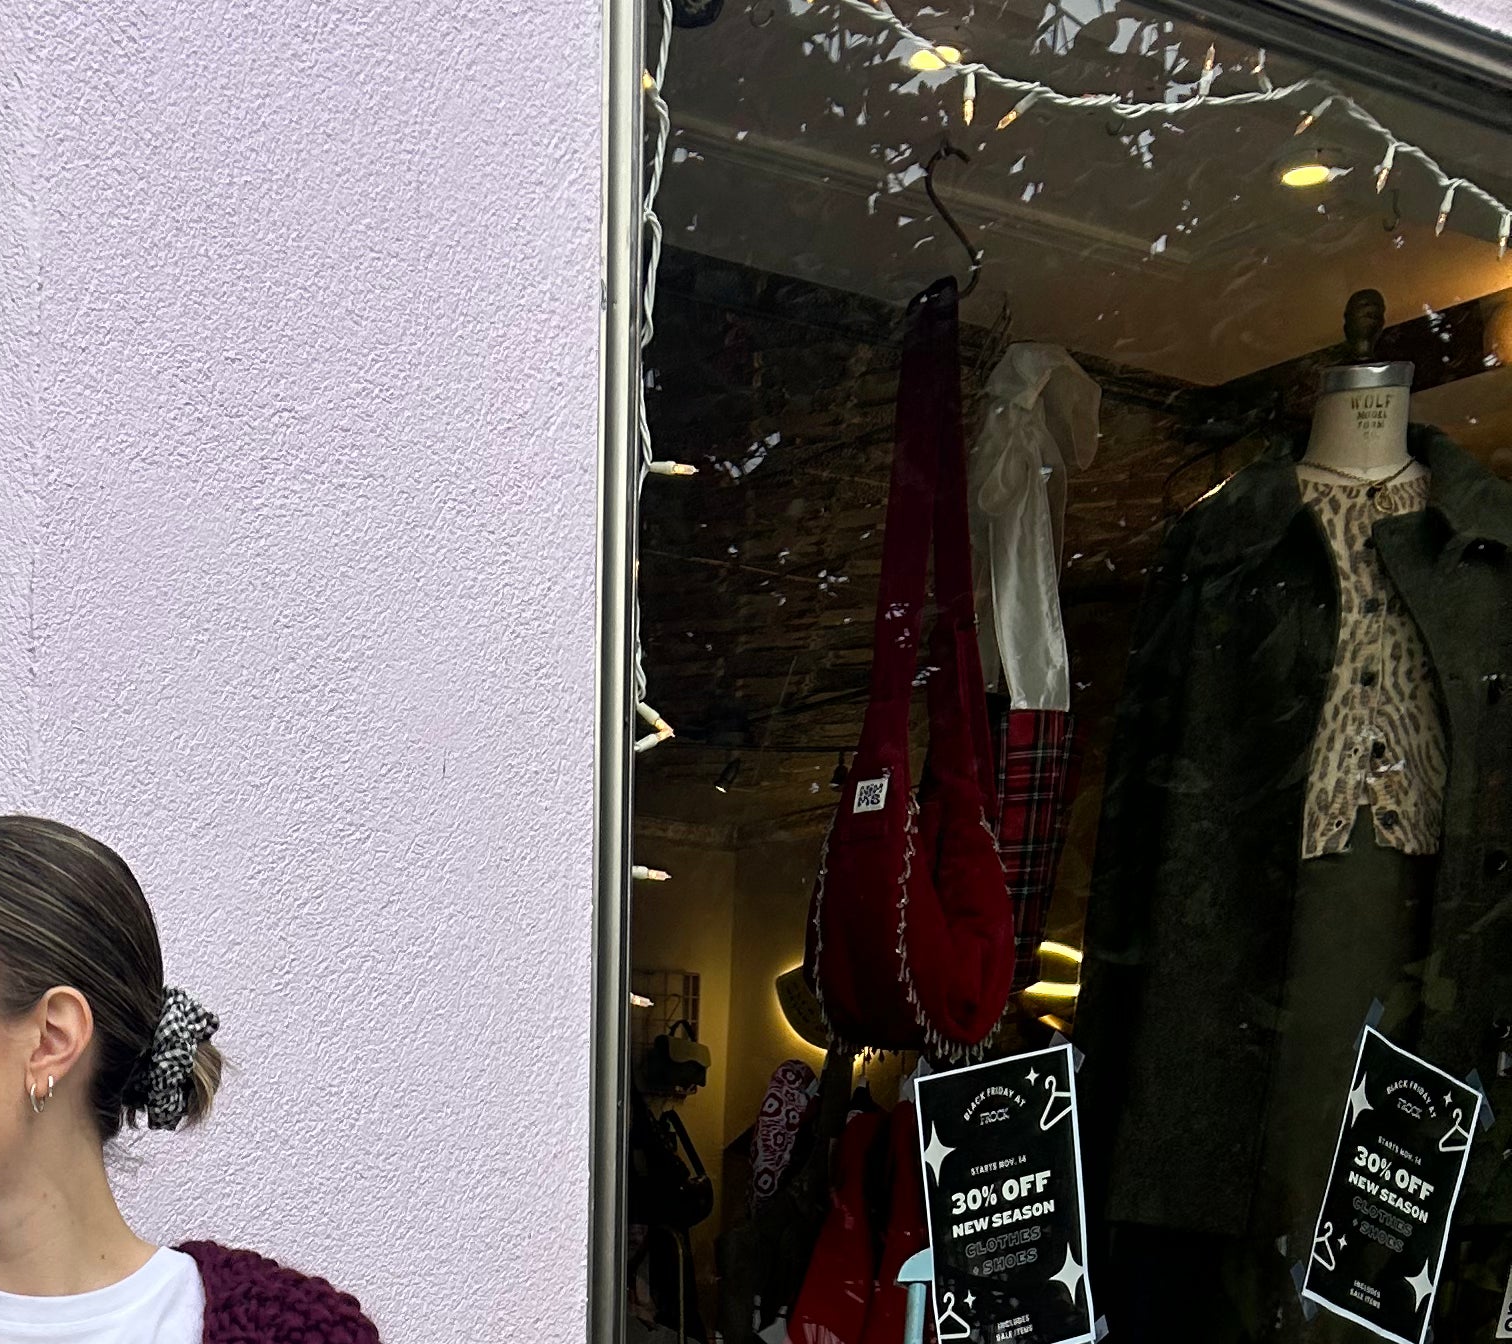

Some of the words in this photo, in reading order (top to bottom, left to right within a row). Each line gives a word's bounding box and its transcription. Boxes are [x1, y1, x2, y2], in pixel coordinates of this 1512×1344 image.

[963, 1091, 986, 1121] BLACK
[986, 1086, 1014, 1098] FRIDAY
[1014, 1094, 1026, 1107] AT
[1386, 1080, 1408, 1095] BLACK
[1409, 1080, 1432, 1104] FRIDAY
[1377, 1135, 1399, 1154] STARTS
[970, 1162, 997, 1176] STARTS
[1354, 1145, 1392, 1181] 30%
[1395, 1168, 1435, 1201] OFF
[951, 1184, 997, 1215] 30%
[1001, 1170, 1051, 1201] OFF
[1348, 1170, 1380, 1196] NEW
[1379, 1188, 1429, 1224] SEASON
[952, 1216, 989, 1238] NEW
[991, 1199, 1055, 1228] SEASON
[1352, 1196, 1413, 1237] CLOTHES
[965, 1225, 1042, 1258] CLOTHES
[1359, 1221, 1405, 1253] SHOES
[982, 1248, 1038, 1275] SHOES
